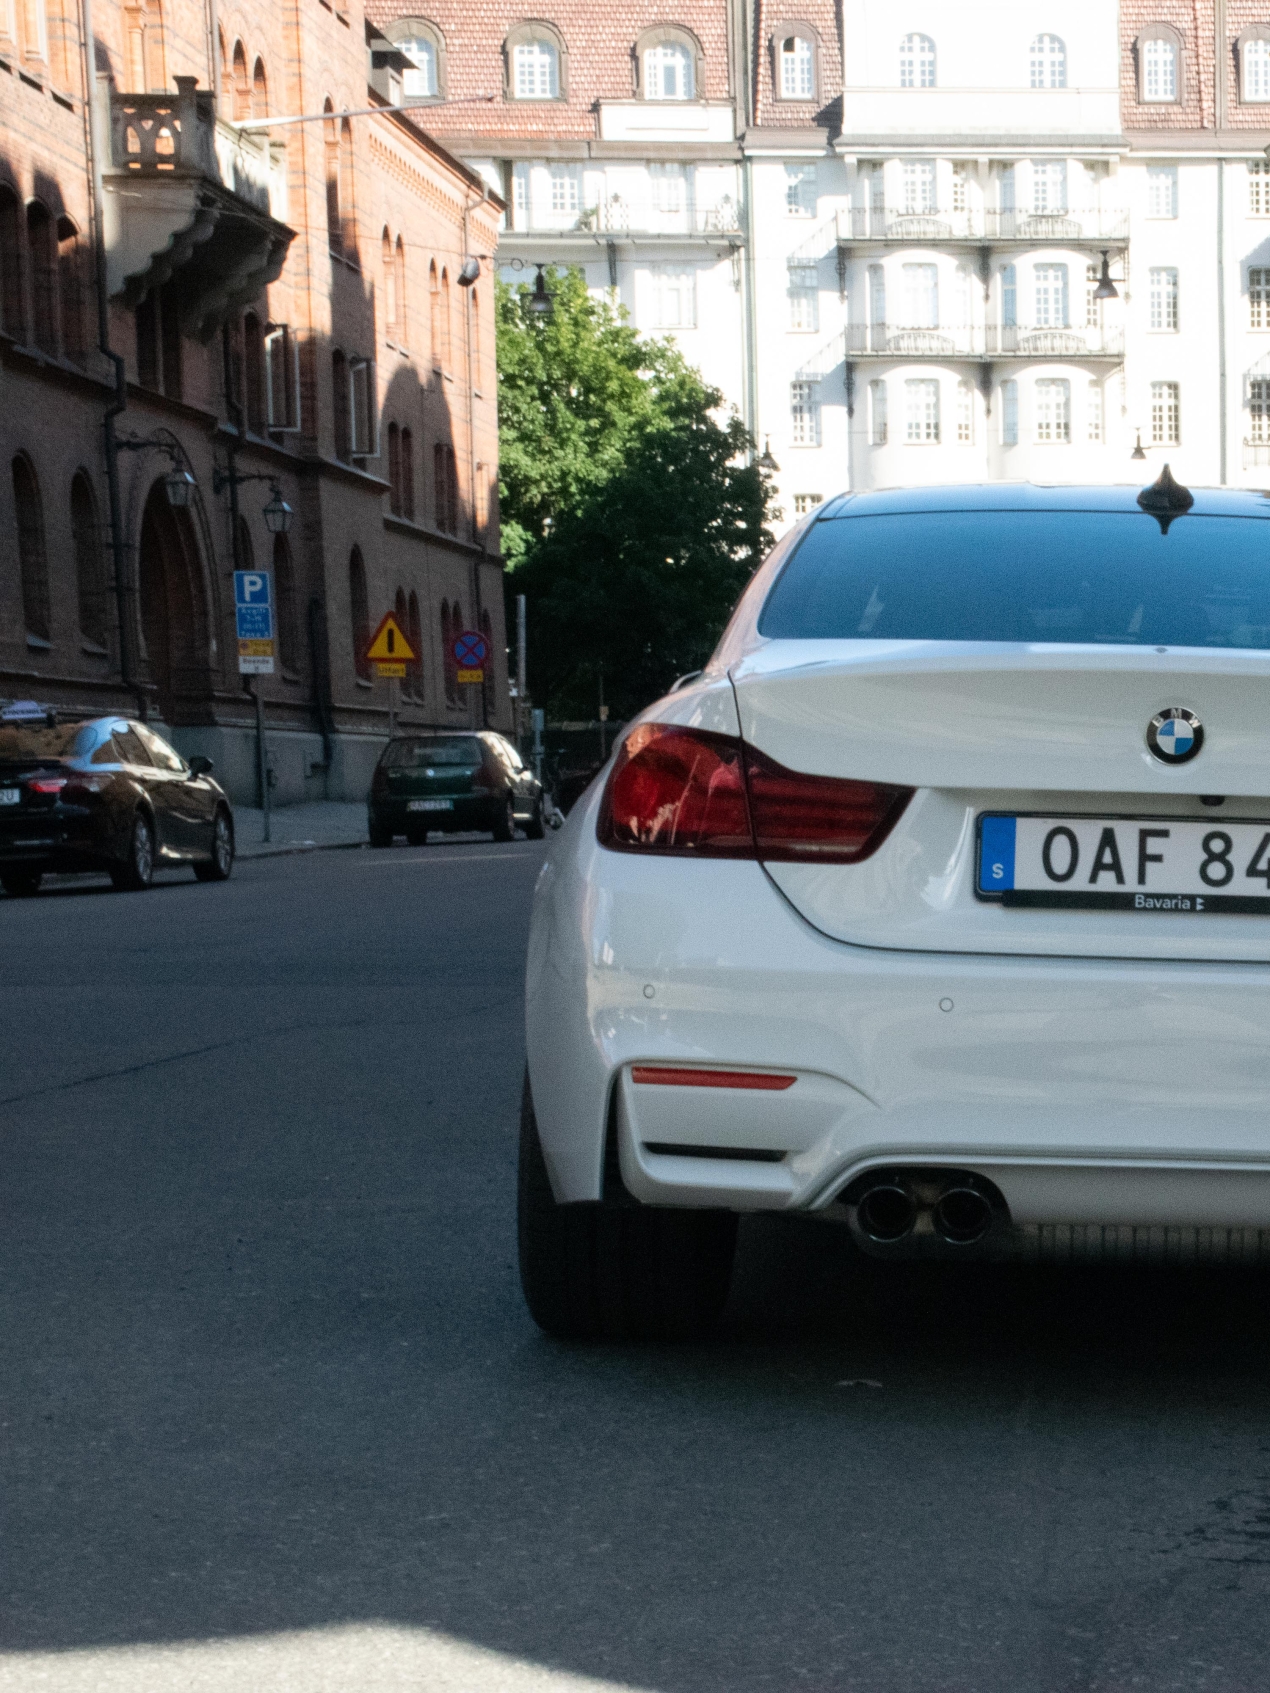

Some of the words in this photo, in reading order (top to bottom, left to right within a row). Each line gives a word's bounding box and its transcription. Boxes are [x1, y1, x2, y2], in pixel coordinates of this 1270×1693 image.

[243, 574, 263, 602] P
[1151, 708, 1201, 729] BMW
[1042, 826, 1170, 885] OAF
[992, 863, 1004, 879] S
[1135, 894, 1191, 910] Bavaria
